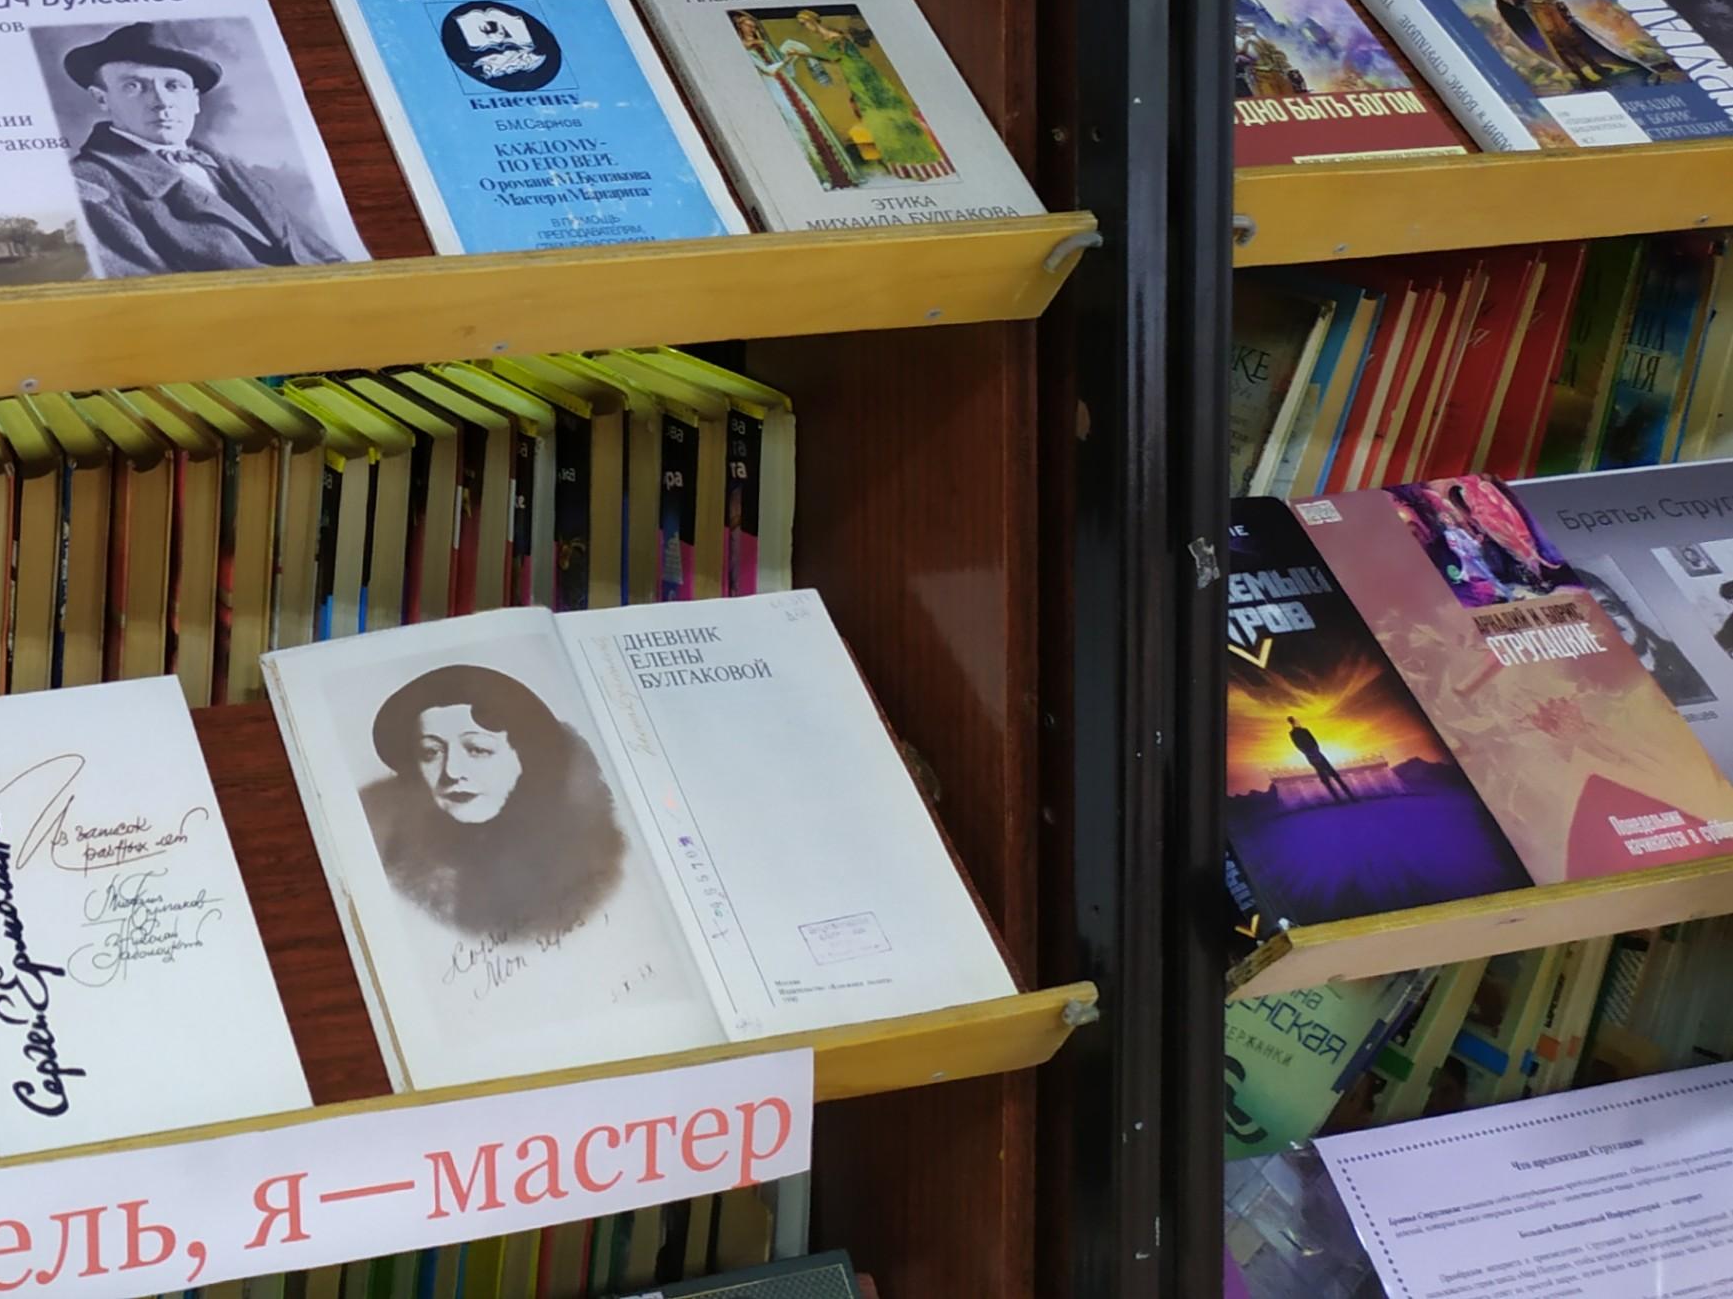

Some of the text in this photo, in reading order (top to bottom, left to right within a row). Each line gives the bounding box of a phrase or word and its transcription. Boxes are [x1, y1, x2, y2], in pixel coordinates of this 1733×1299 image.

[1286, 94, 1349, 122] БЫТЬ
[1347, 89, 1428, 118] БОГОМ
[498, 159, 529, 173] ПО
[533, 156, 568, 172] ЕГО
[871, 195, 937, 211] ЭТИКА
[1558, 490, 1733, 531] Братья Струг
[624, 626, 722, 652] ДНЕВНИК
[1486, 622, 1608, 667] СТРУГАЦКИЕ
[629, 648, 705, 670] ЕЛЕНЫ
[638, 657, 773, 689] БУЛГАКОВОЙ
